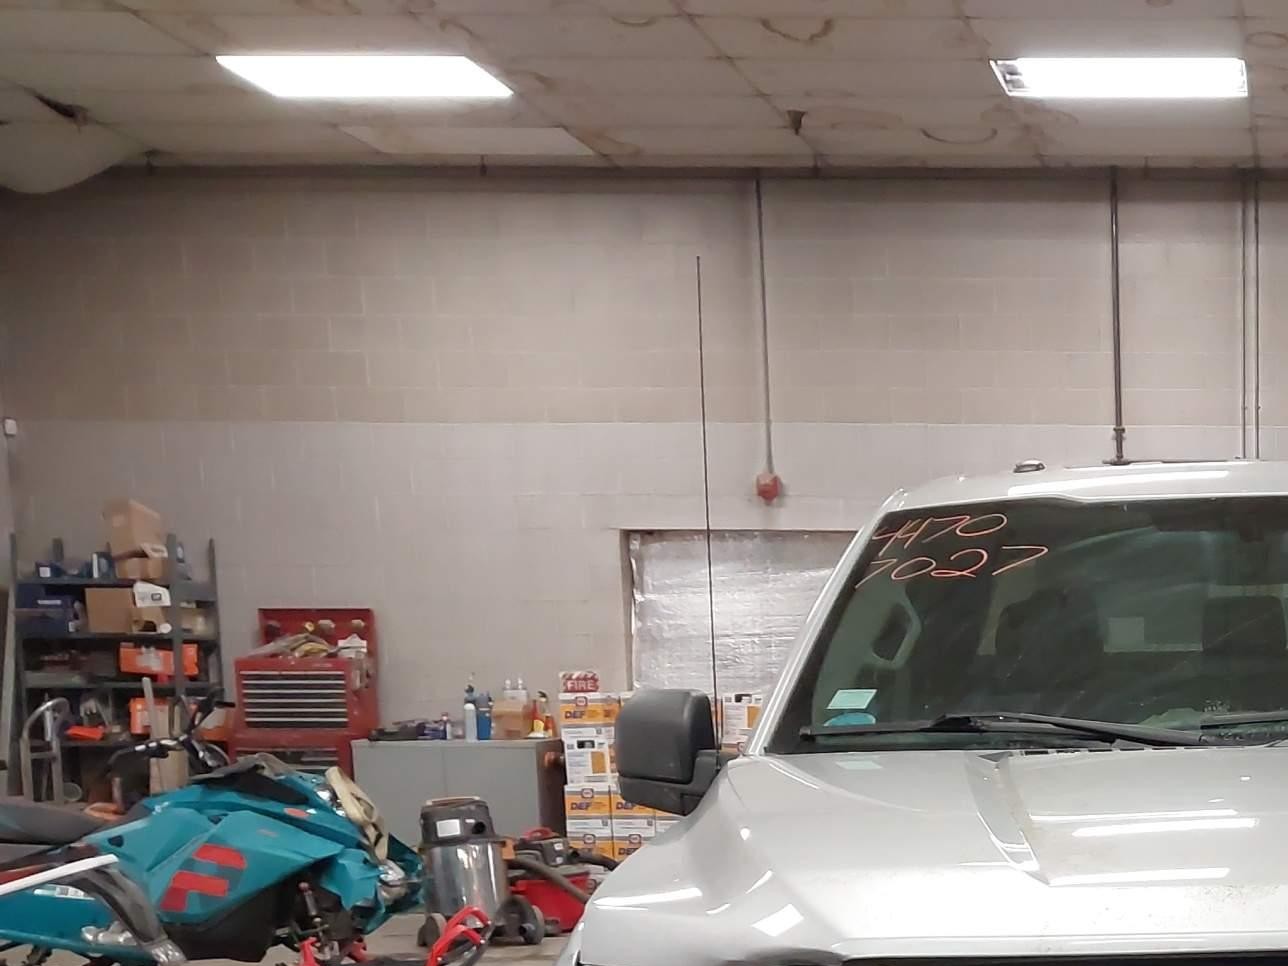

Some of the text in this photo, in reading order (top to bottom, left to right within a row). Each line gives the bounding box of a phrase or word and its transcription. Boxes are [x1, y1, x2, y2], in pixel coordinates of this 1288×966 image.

[872, 514, 1007, 557] 4470
[855, 545, 1049, 589] 7027
[567, 681, 596, 690] FIRE
[564, 709, 585, 719] DEF
[571, 802, 592, 811] DEF
